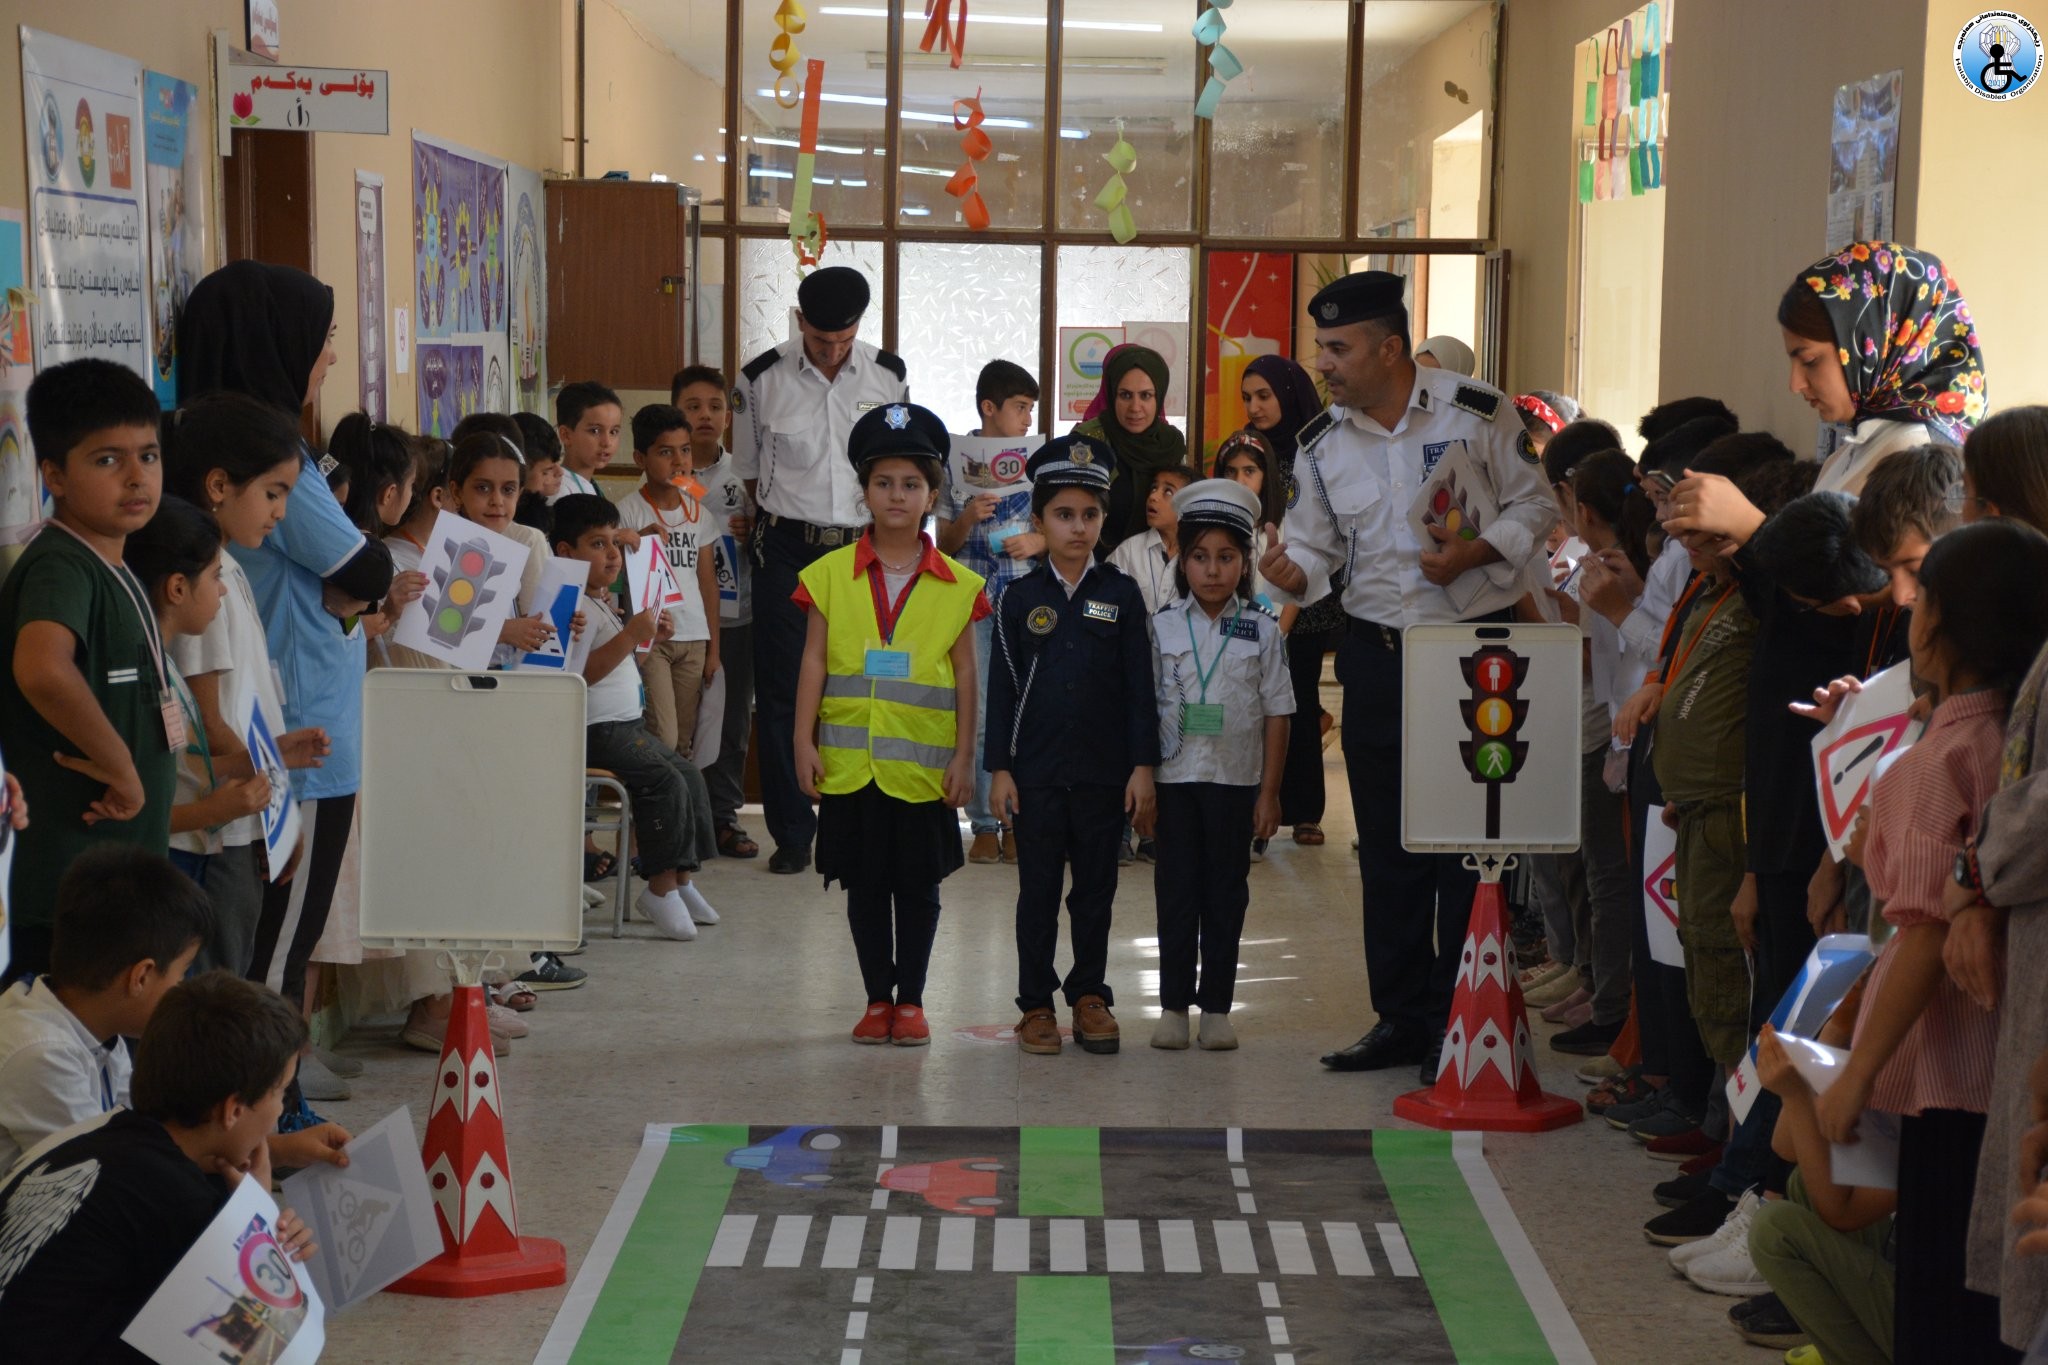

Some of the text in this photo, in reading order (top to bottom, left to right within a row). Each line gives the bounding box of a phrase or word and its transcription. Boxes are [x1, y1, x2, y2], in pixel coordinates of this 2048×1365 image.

[998, 459, 1020, 476] 30
[665, 531, 697, 549] REAK
[1088, 602, 1115, 613] TRAFFIC
[1088, 608, 1112, 618] POLICE
[1677, 670, 1708, 720] NETWORK
[255, 1246, 292, 1297] 30
